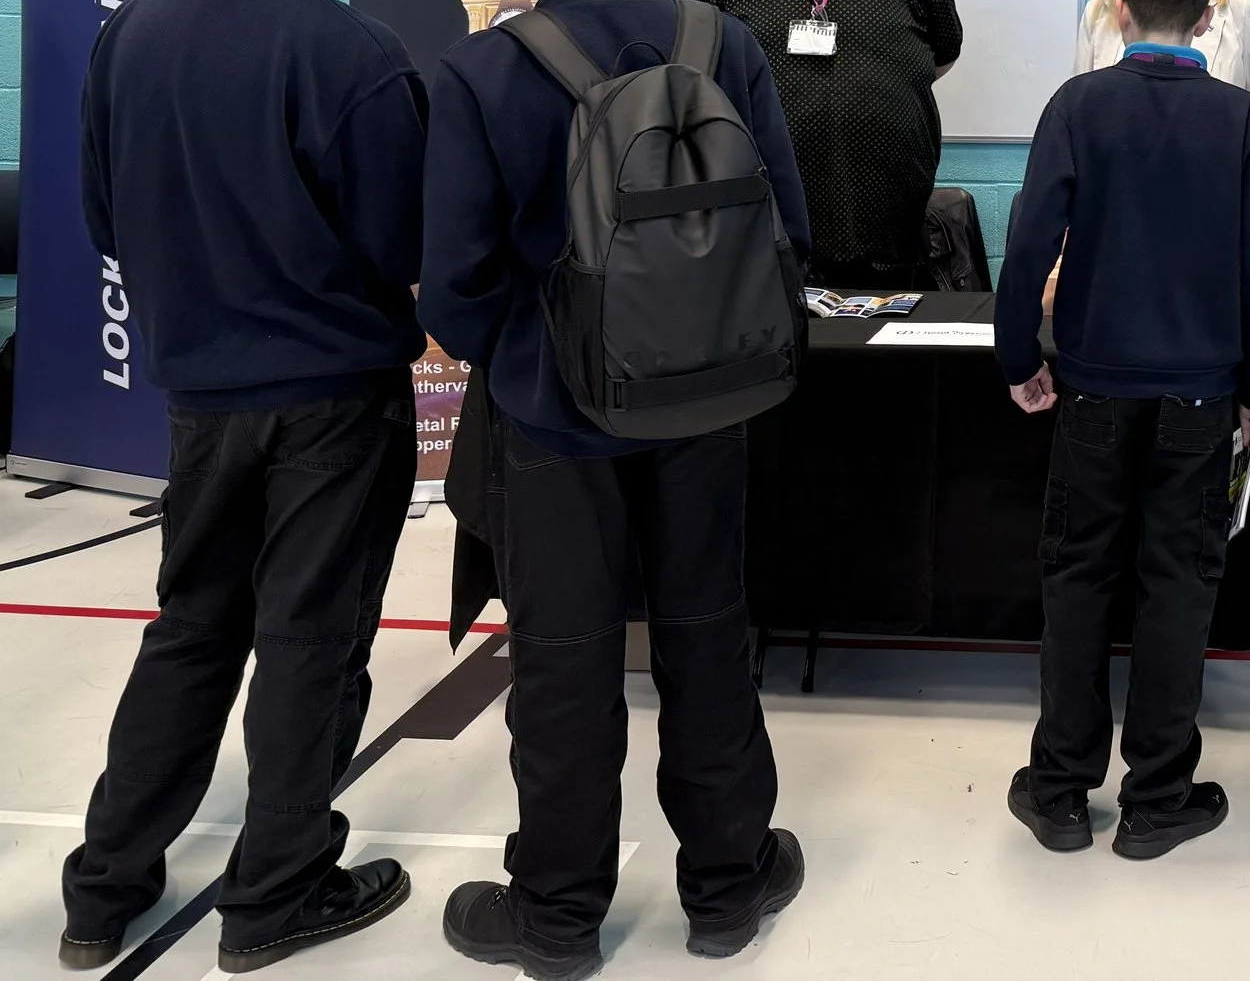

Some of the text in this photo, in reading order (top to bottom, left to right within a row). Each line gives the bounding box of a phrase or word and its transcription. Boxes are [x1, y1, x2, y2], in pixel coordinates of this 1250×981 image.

[102, 254, 130, 390] LOCK
[412, 360, 443, 374] cks
[416, 417, 445, 432] etal
